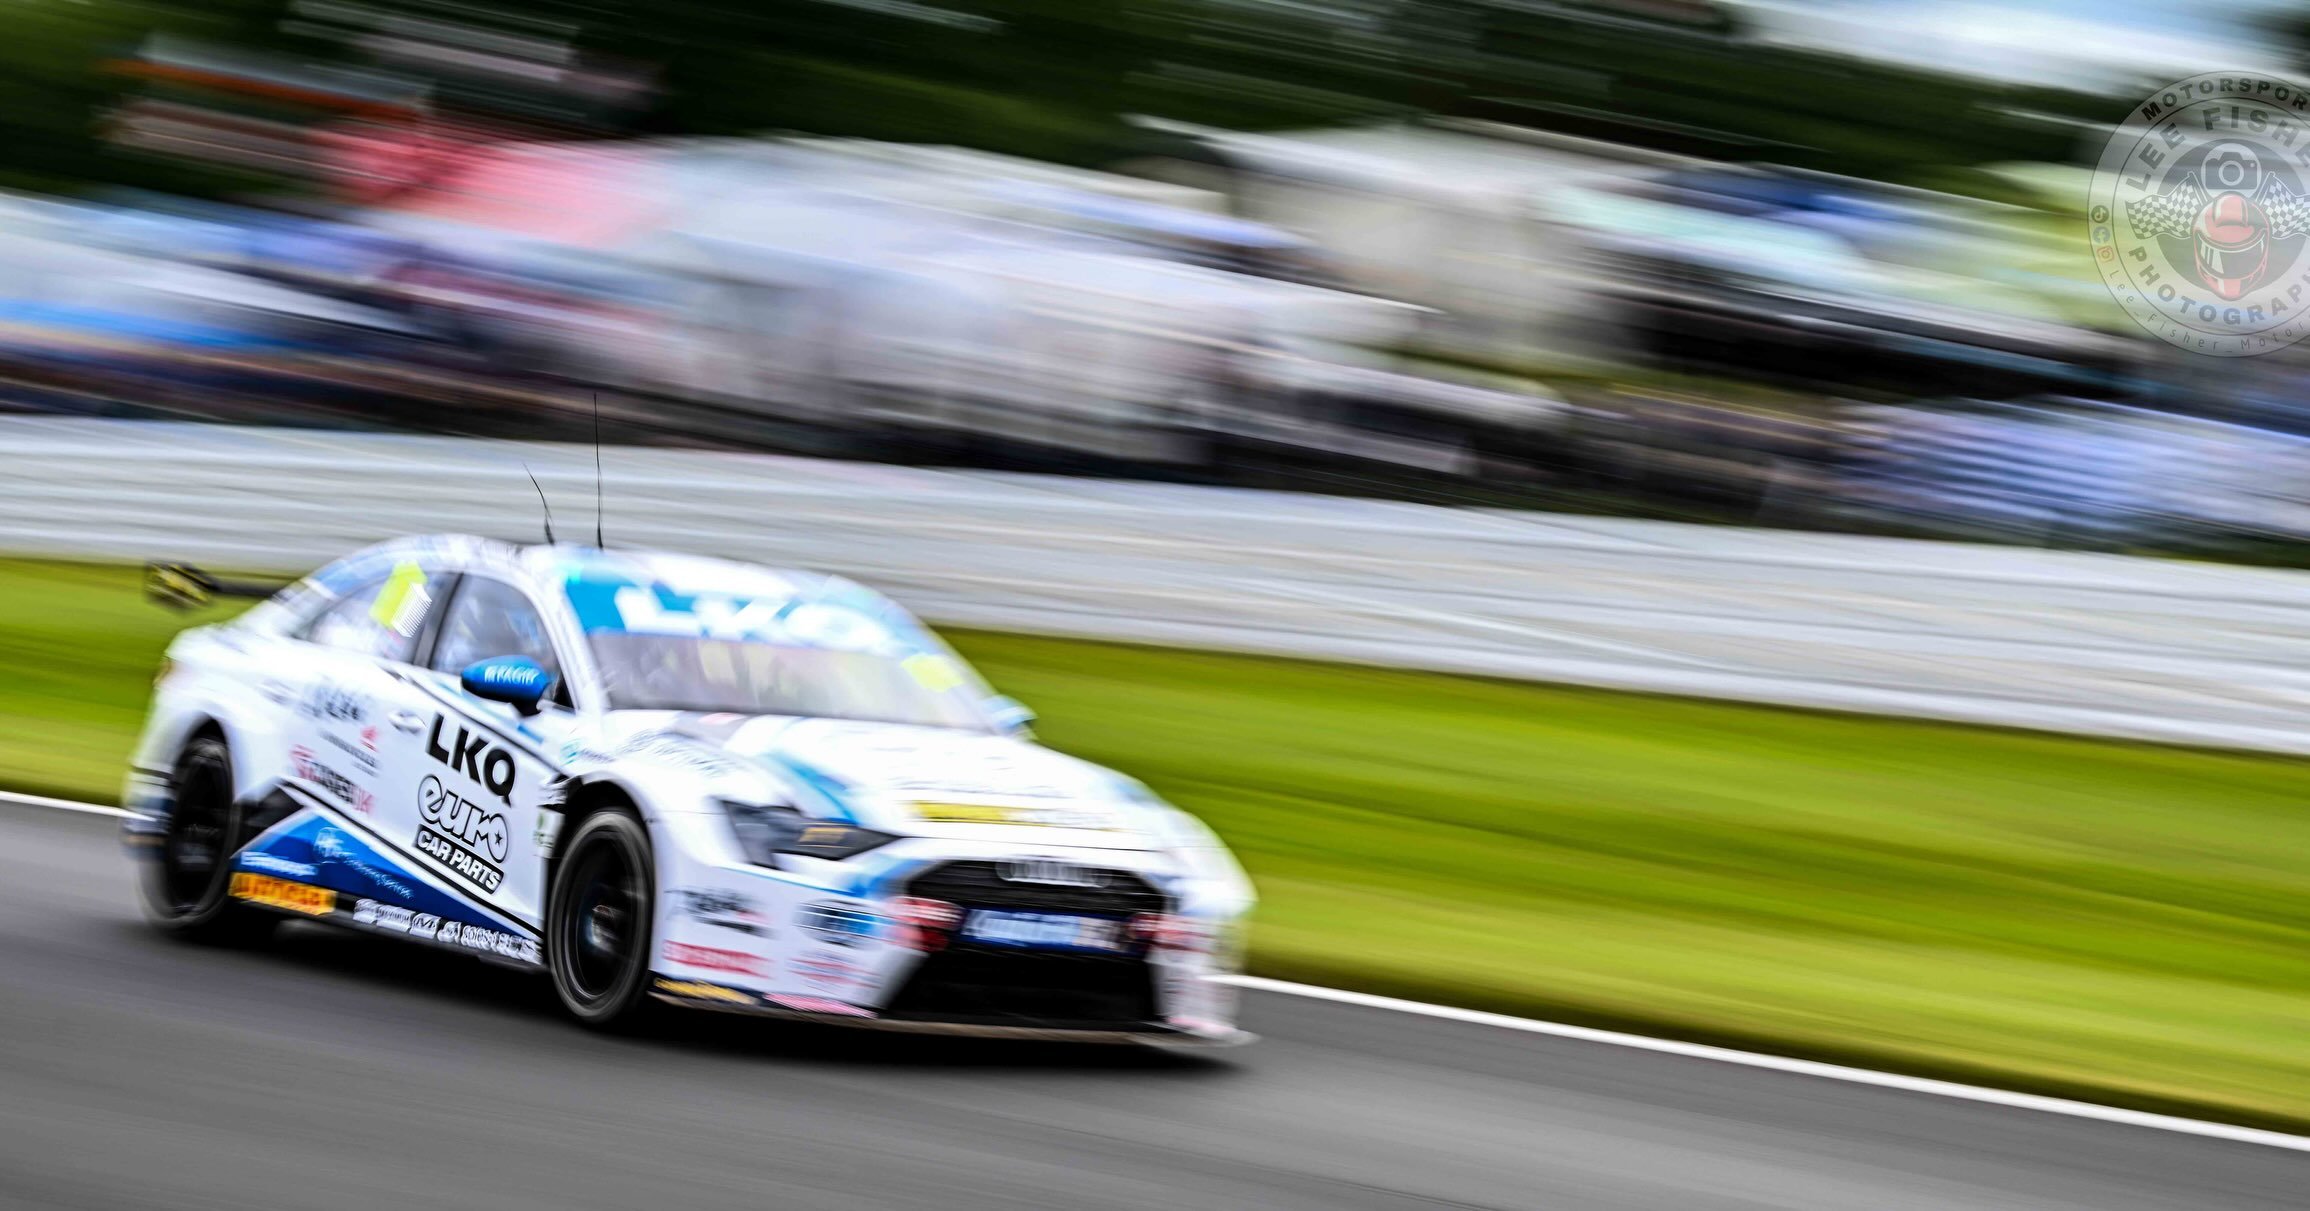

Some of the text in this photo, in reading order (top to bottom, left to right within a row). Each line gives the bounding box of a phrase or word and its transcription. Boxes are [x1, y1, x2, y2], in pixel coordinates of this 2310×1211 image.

[425, 712, 516, 808] LKQ
[417, 829, 452, 862] CAR
[450, 847, 501, 891] PARTS
[418, 774, 509, 863] euro
